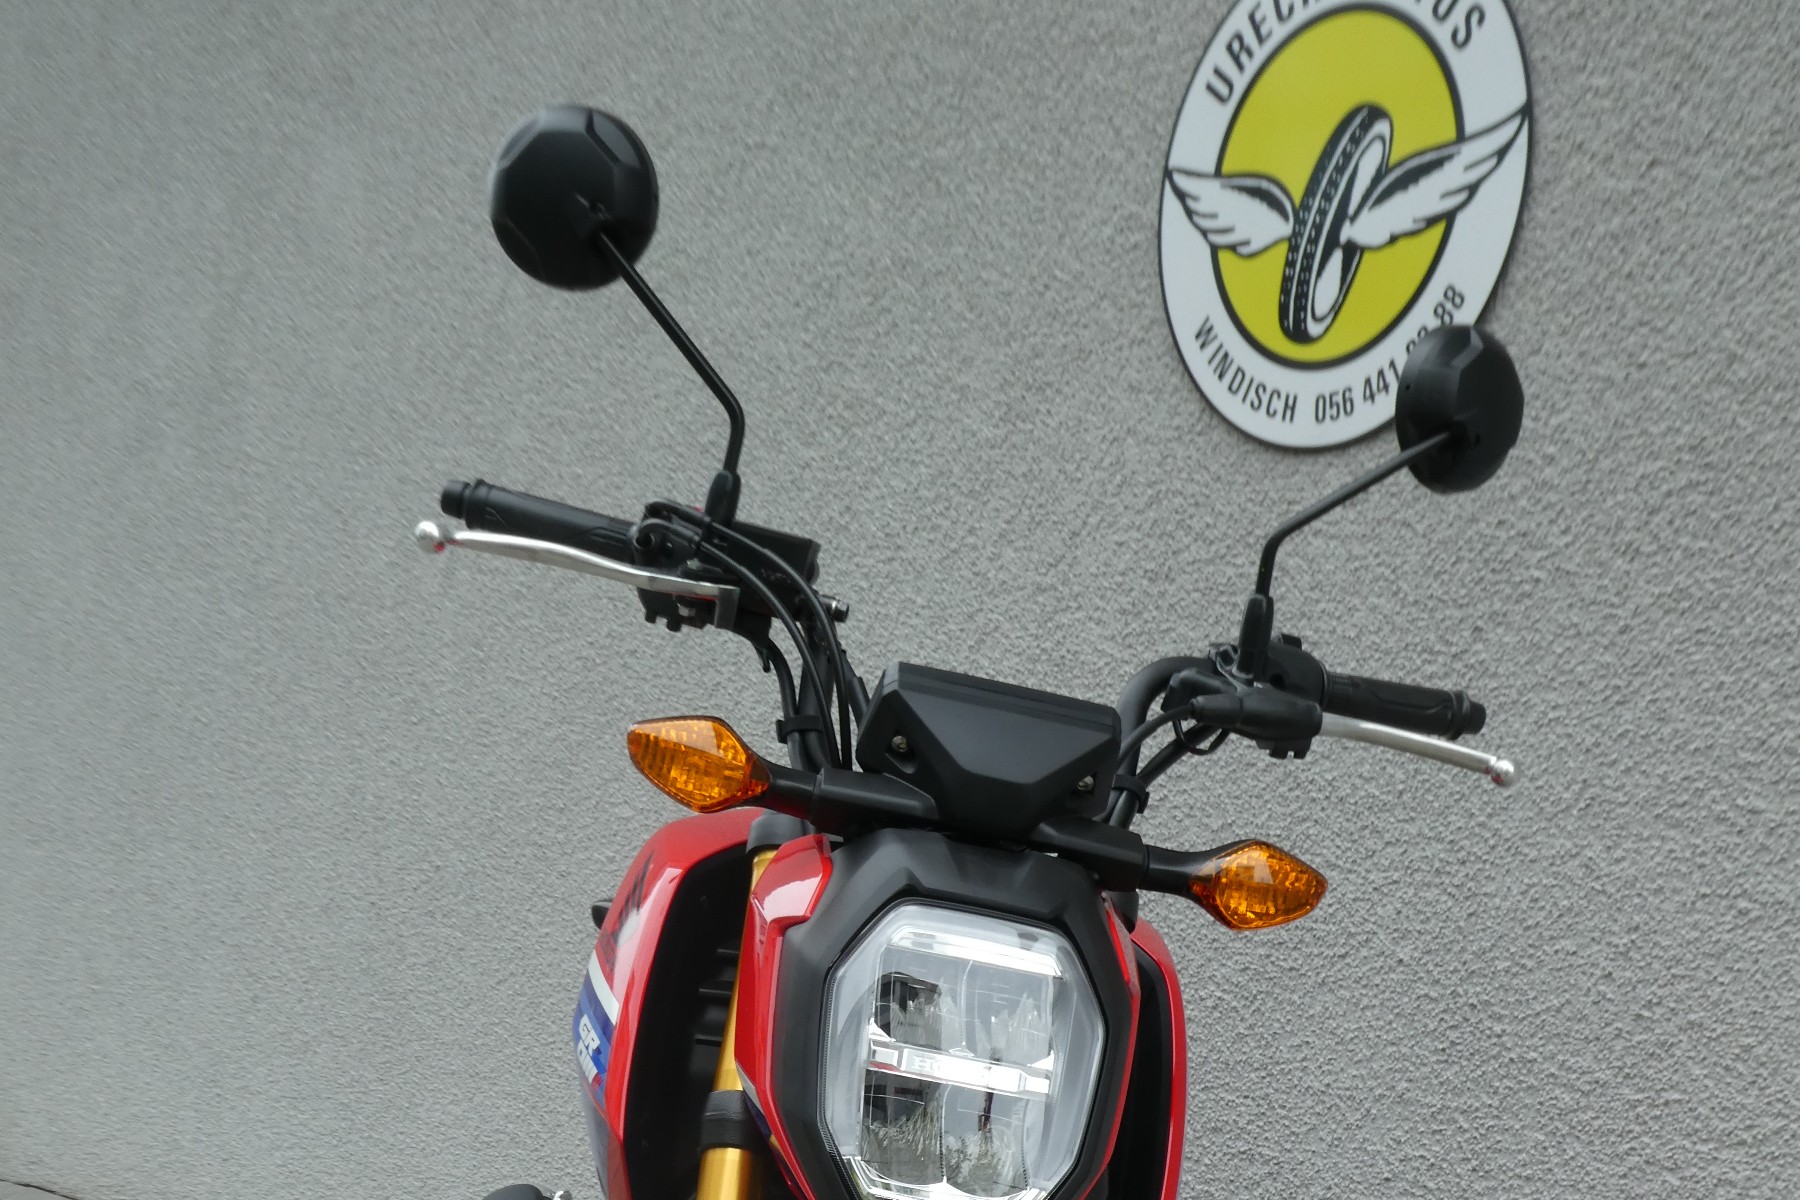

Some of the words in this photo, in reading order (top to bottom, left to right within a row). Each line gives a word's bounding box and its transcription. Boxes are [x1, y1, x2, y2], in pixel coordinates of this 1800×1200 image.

[1206, 0, 1320, 105] UREC
[1194, 315, 1298, 424] WINDISCH
[1314, 387, 1354, 424] 056
[1362, 358, 1399, 405] 441
